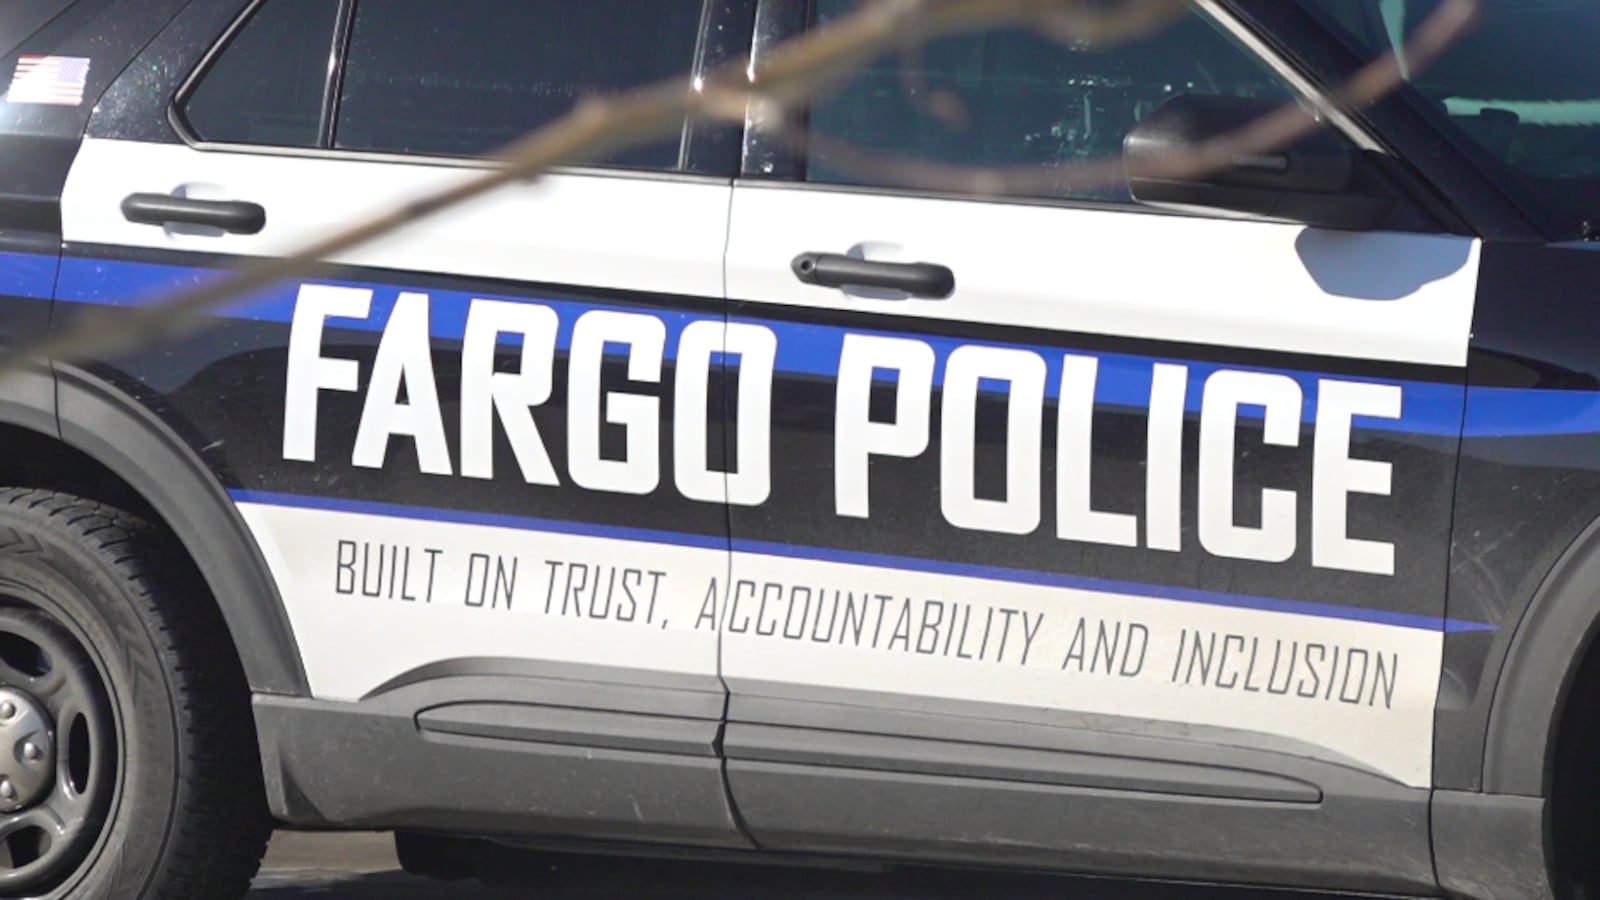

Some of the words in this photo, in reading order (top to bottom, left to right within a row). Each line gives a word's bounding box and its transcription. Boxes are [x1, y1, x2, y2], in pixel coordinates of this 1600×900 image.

[281, 283, 778, 507] FARGO
[834, 331, 1403, 577] POLICE
[336, 540, 443, 602] BUILT
[464, 553, 518, 610] ON
[544, 560, 667, 629] TRUST,
[695, 577, 1044, 665] ACCOUNTABILITY
[1061, 617, 1150, 678] AND
[1171, 628, 1399, 709] INCLUSION
